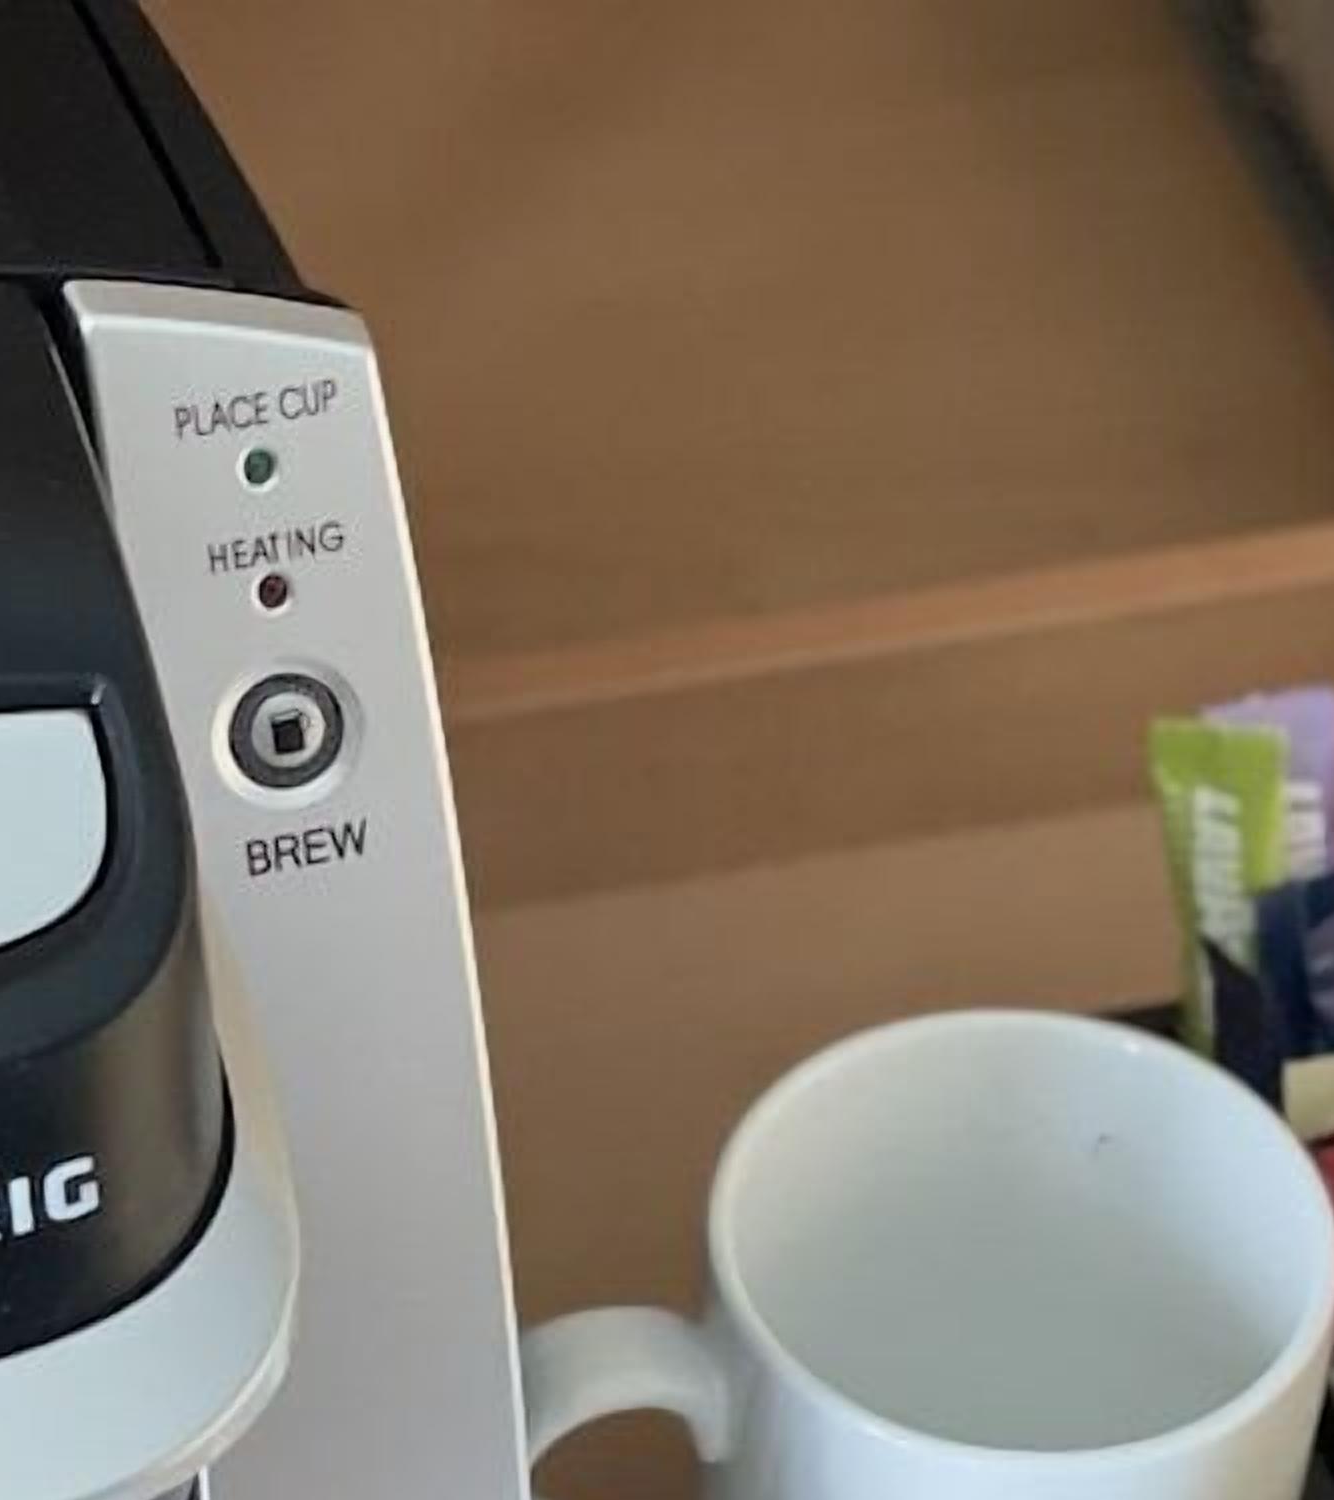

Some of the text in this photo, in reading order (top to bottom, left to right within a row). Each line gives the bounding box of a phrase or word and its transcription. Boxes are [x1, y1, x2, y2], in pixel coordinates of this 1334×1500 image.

[174, 379, 339, 439] PLACE CUP
[207, 521, 345, 574] HEATING
[246, 820, 367, 877] BREW
